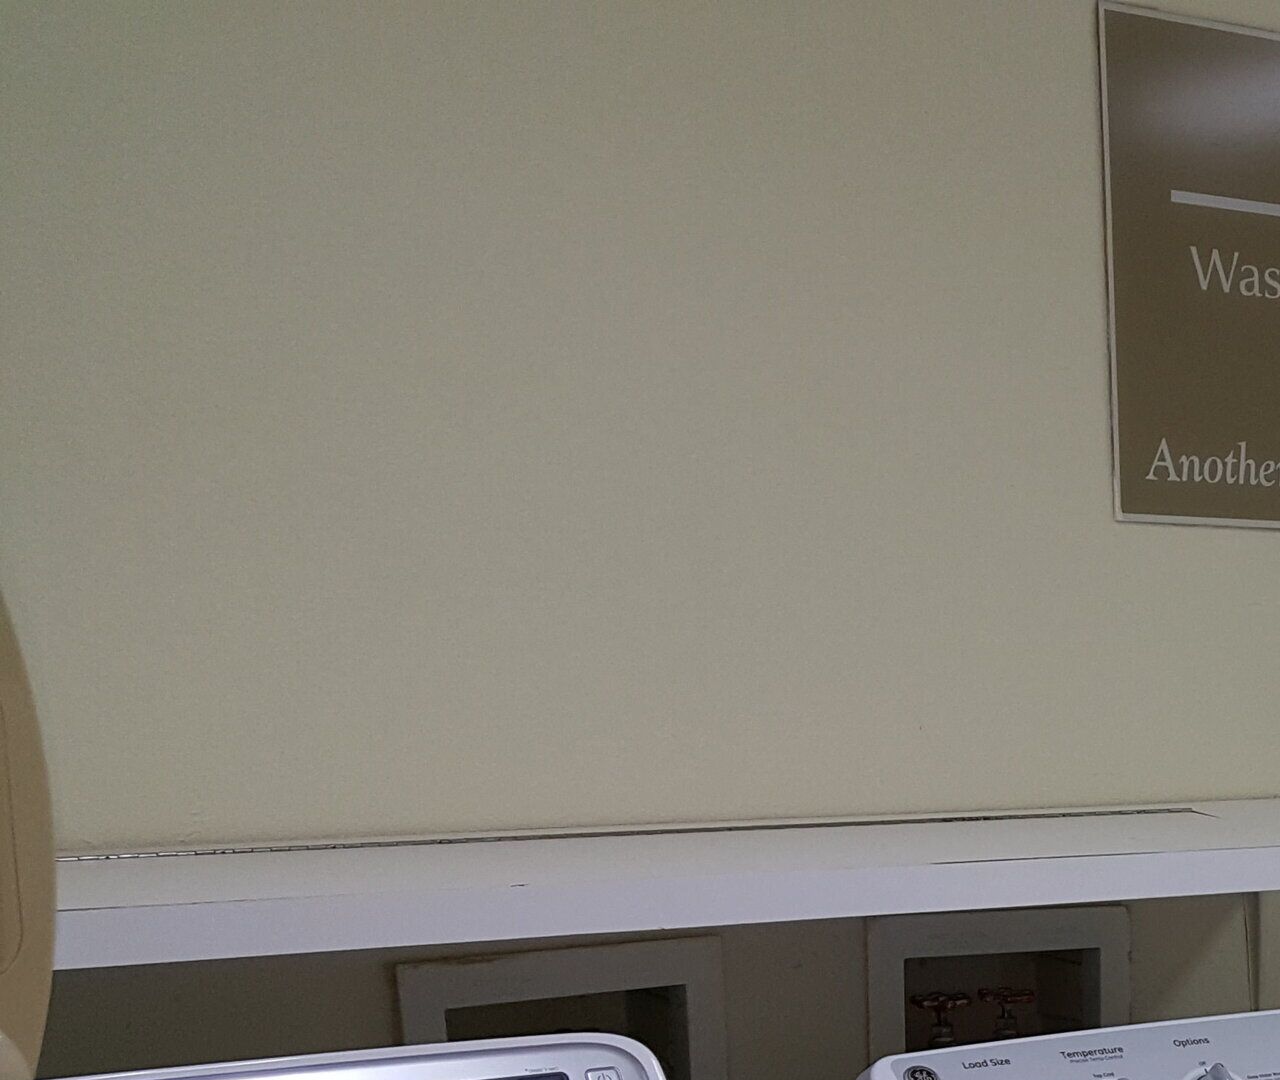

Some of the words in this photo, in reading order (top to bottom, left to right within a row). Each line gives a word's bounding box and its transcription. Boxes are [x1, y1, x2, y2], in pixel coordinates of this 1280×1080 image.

[1173, 1037, 1210, 1048] Options
[1059, 1046, 1124, 1060] Temperature
[962, 1060, 988, 1070] Load
[989, 1057, 1011, 1067] Size
